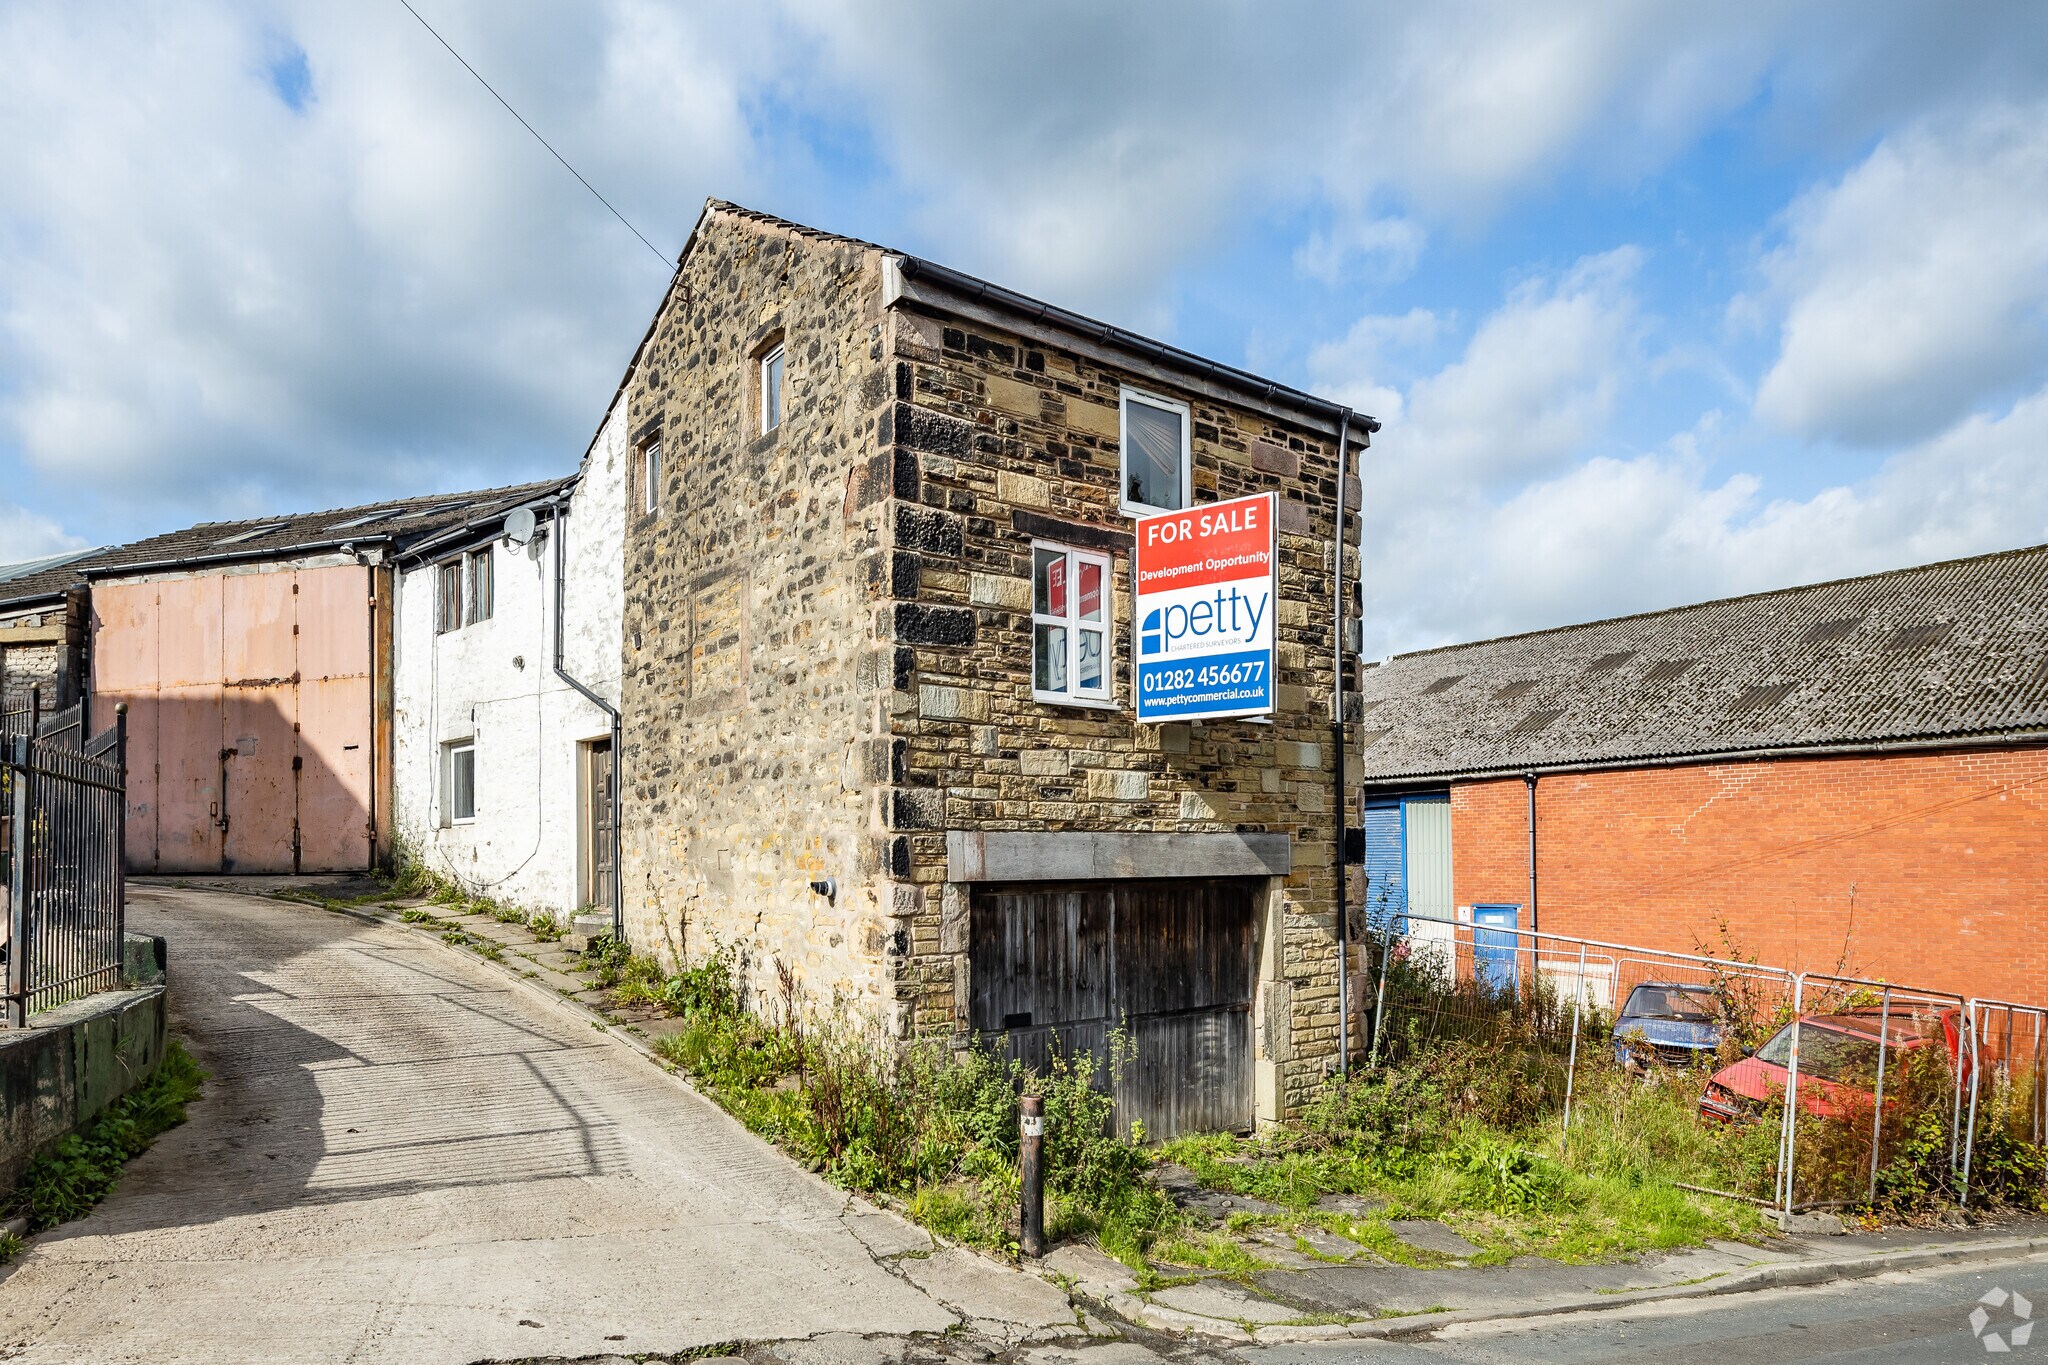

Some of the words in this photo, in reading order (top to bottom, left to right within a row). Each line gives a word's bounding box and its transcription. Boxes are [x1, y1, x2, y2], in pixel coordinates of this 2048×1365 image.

[1148, 522, 1193, 547] FOR
[1199, 506, 1257, 537] SALE
[1140, 561, 1204, 582] Development
[1206, 550, 1270, 572] Opportunity
[1165, 587, 1268, 652] petty
[1171, 642, 1205, 653] CHARTERED
[1206, 638, 1241, 648] SURVEYORS
[1143, 668, 1194, 692] 01282
[1198, 661, 1265, 686] 456677
[1144, 686, 1265, 707] www.pettycommercial.co.uk
